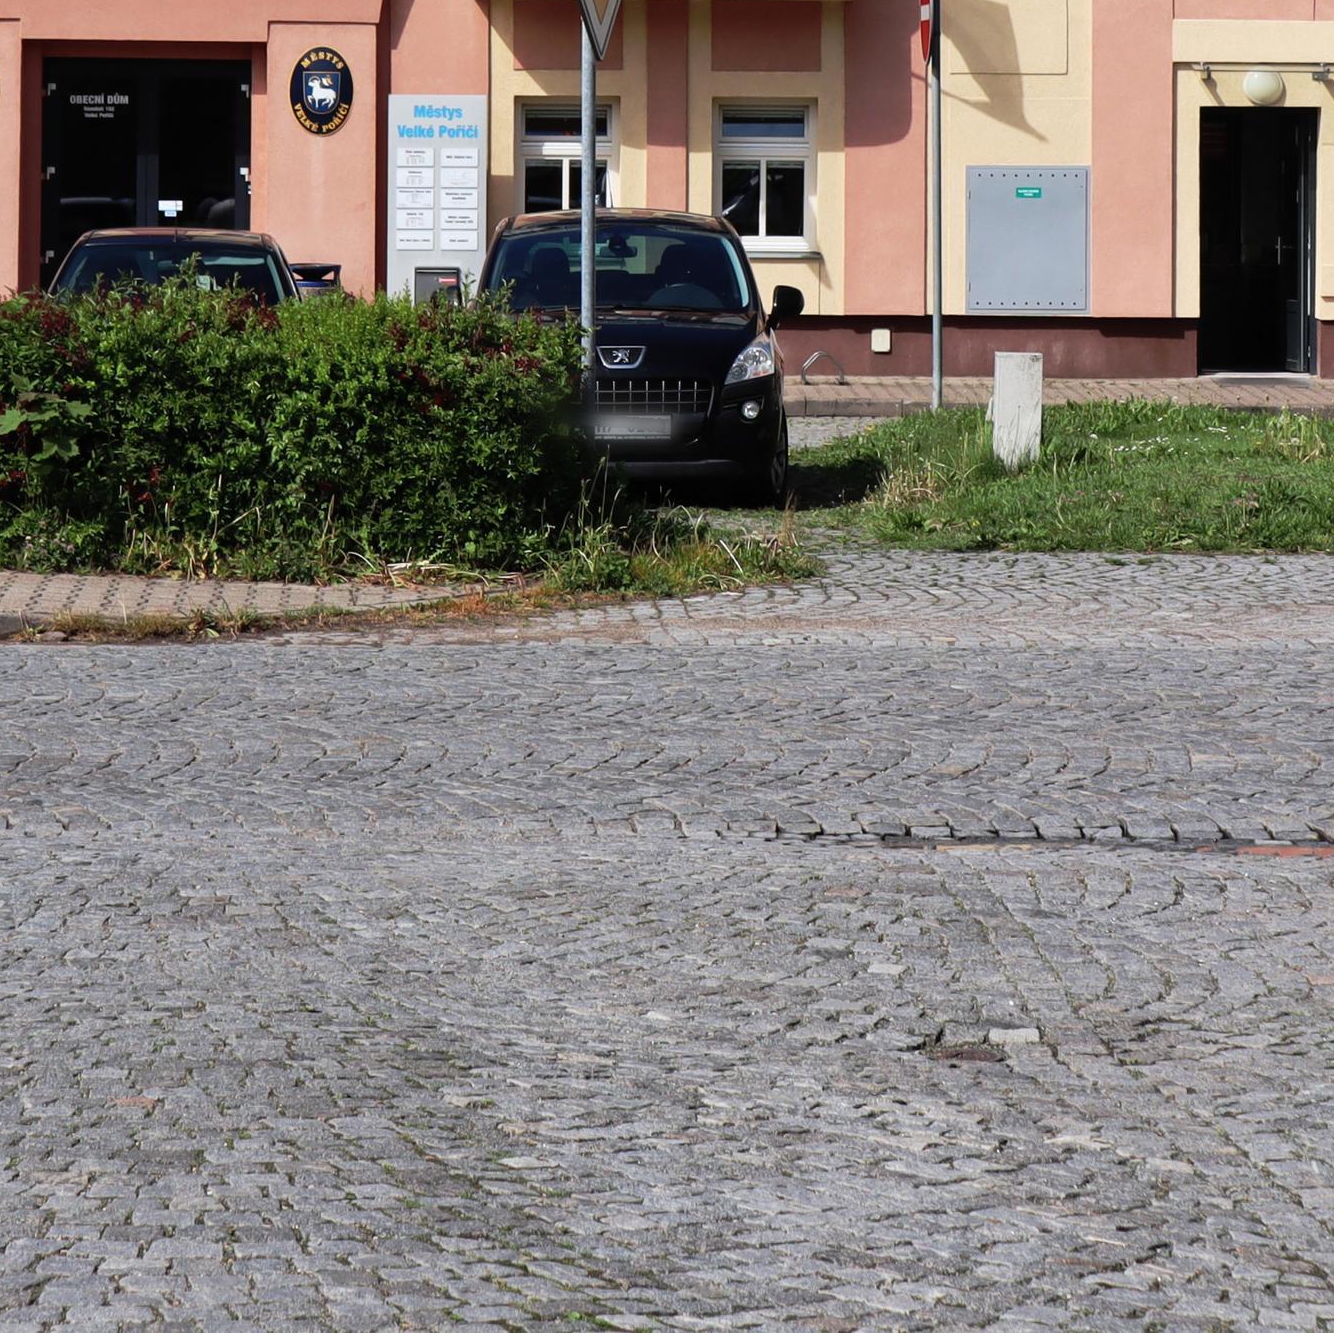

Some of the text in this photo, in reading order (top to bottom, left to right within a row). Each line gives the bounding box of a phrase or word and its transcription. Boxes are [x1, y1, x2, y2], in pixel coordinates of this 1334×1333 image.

[300, 51, 344, 69] MĚSTYS
[69, 92, 129, 104] OBECNÍ DŮM
[294, 103, 319, 132] VELKÉ
[413, 104, 464, 121] Městys
[397, 125, 479, 138] Velké Poříčí
